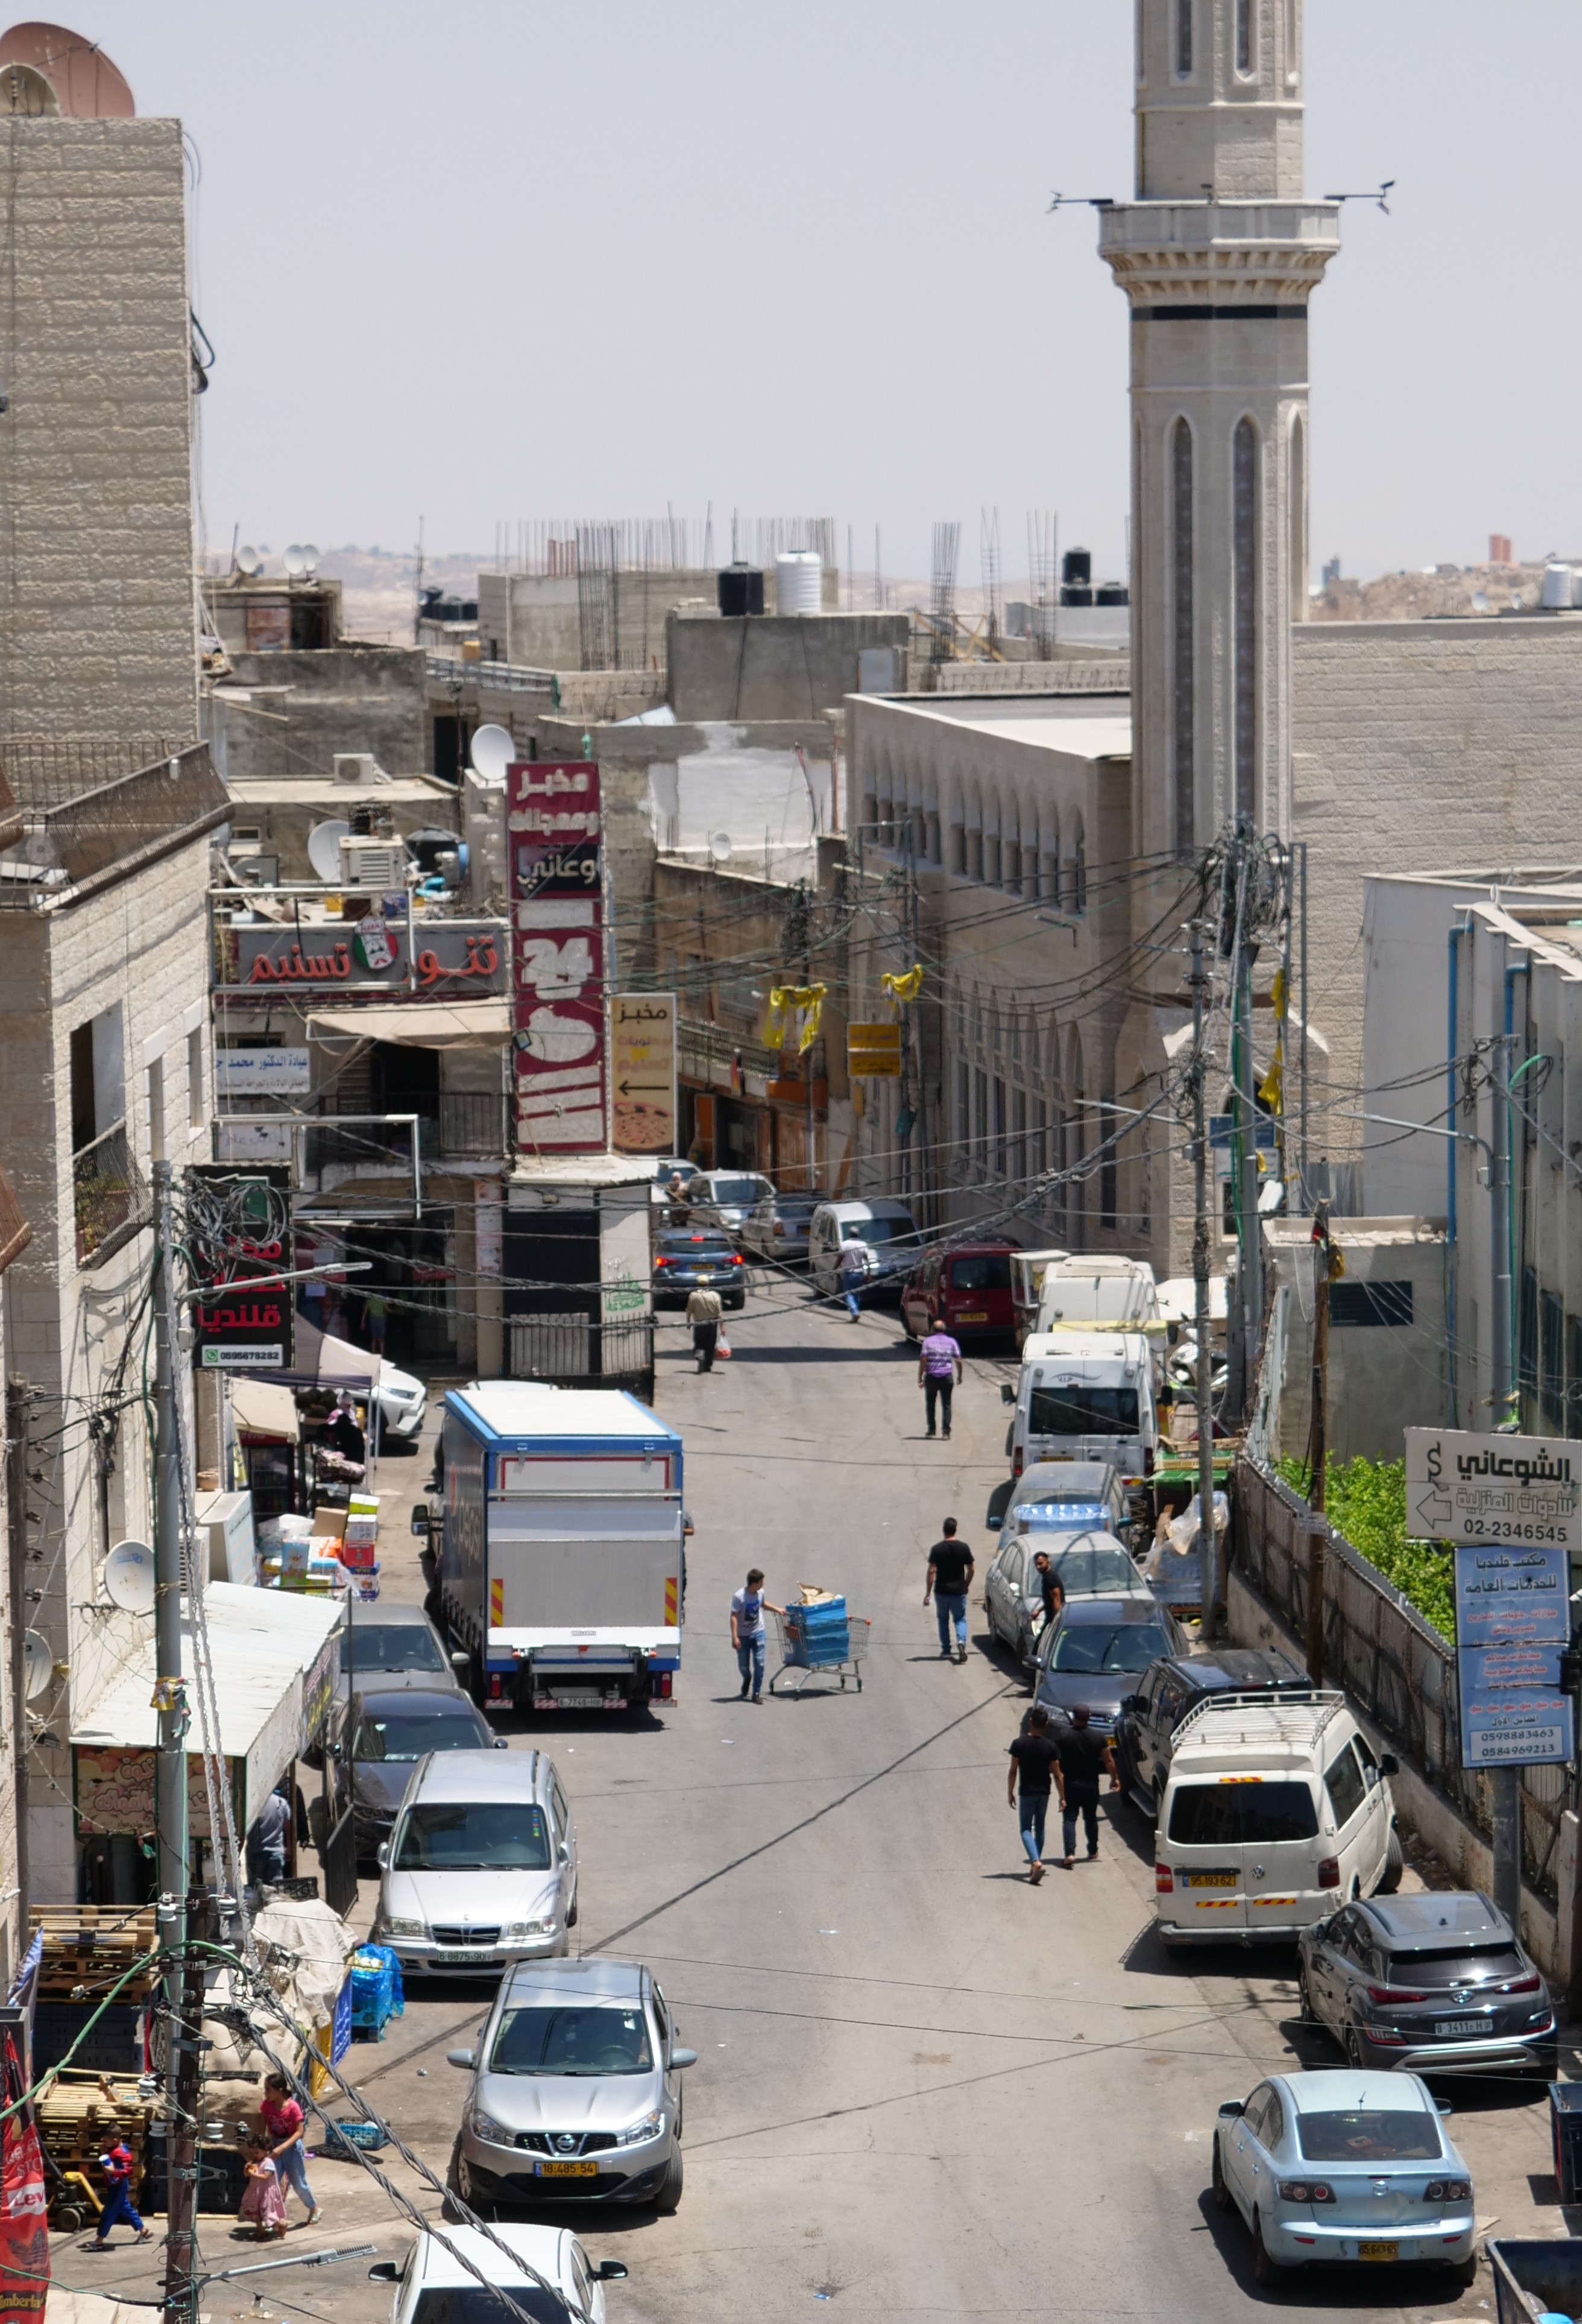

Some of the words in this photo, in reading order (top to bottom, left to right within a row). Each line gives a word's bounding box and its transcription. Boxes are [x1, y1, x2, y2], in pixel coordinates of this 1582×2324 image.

[250, 942, 350, 985] تسنيم
[227, 1058, 254, 1068] محمد
[197, 1304, 281, 1333] قلنديا
[1457, 1447, 1571, 1486] الشوعاني
[1455, 1487, 1514, 1515] المنزلية
[1464, 1518, 1568, 1542] 02-2346545
[1476, 1554, 1509, 1571] قلنديا
[1512, 1552, 1546, 1568] مكتب
[1464, 1577, 1504, 1594] العامة
[1507, 1574, 1557, 1591] للخدمات
